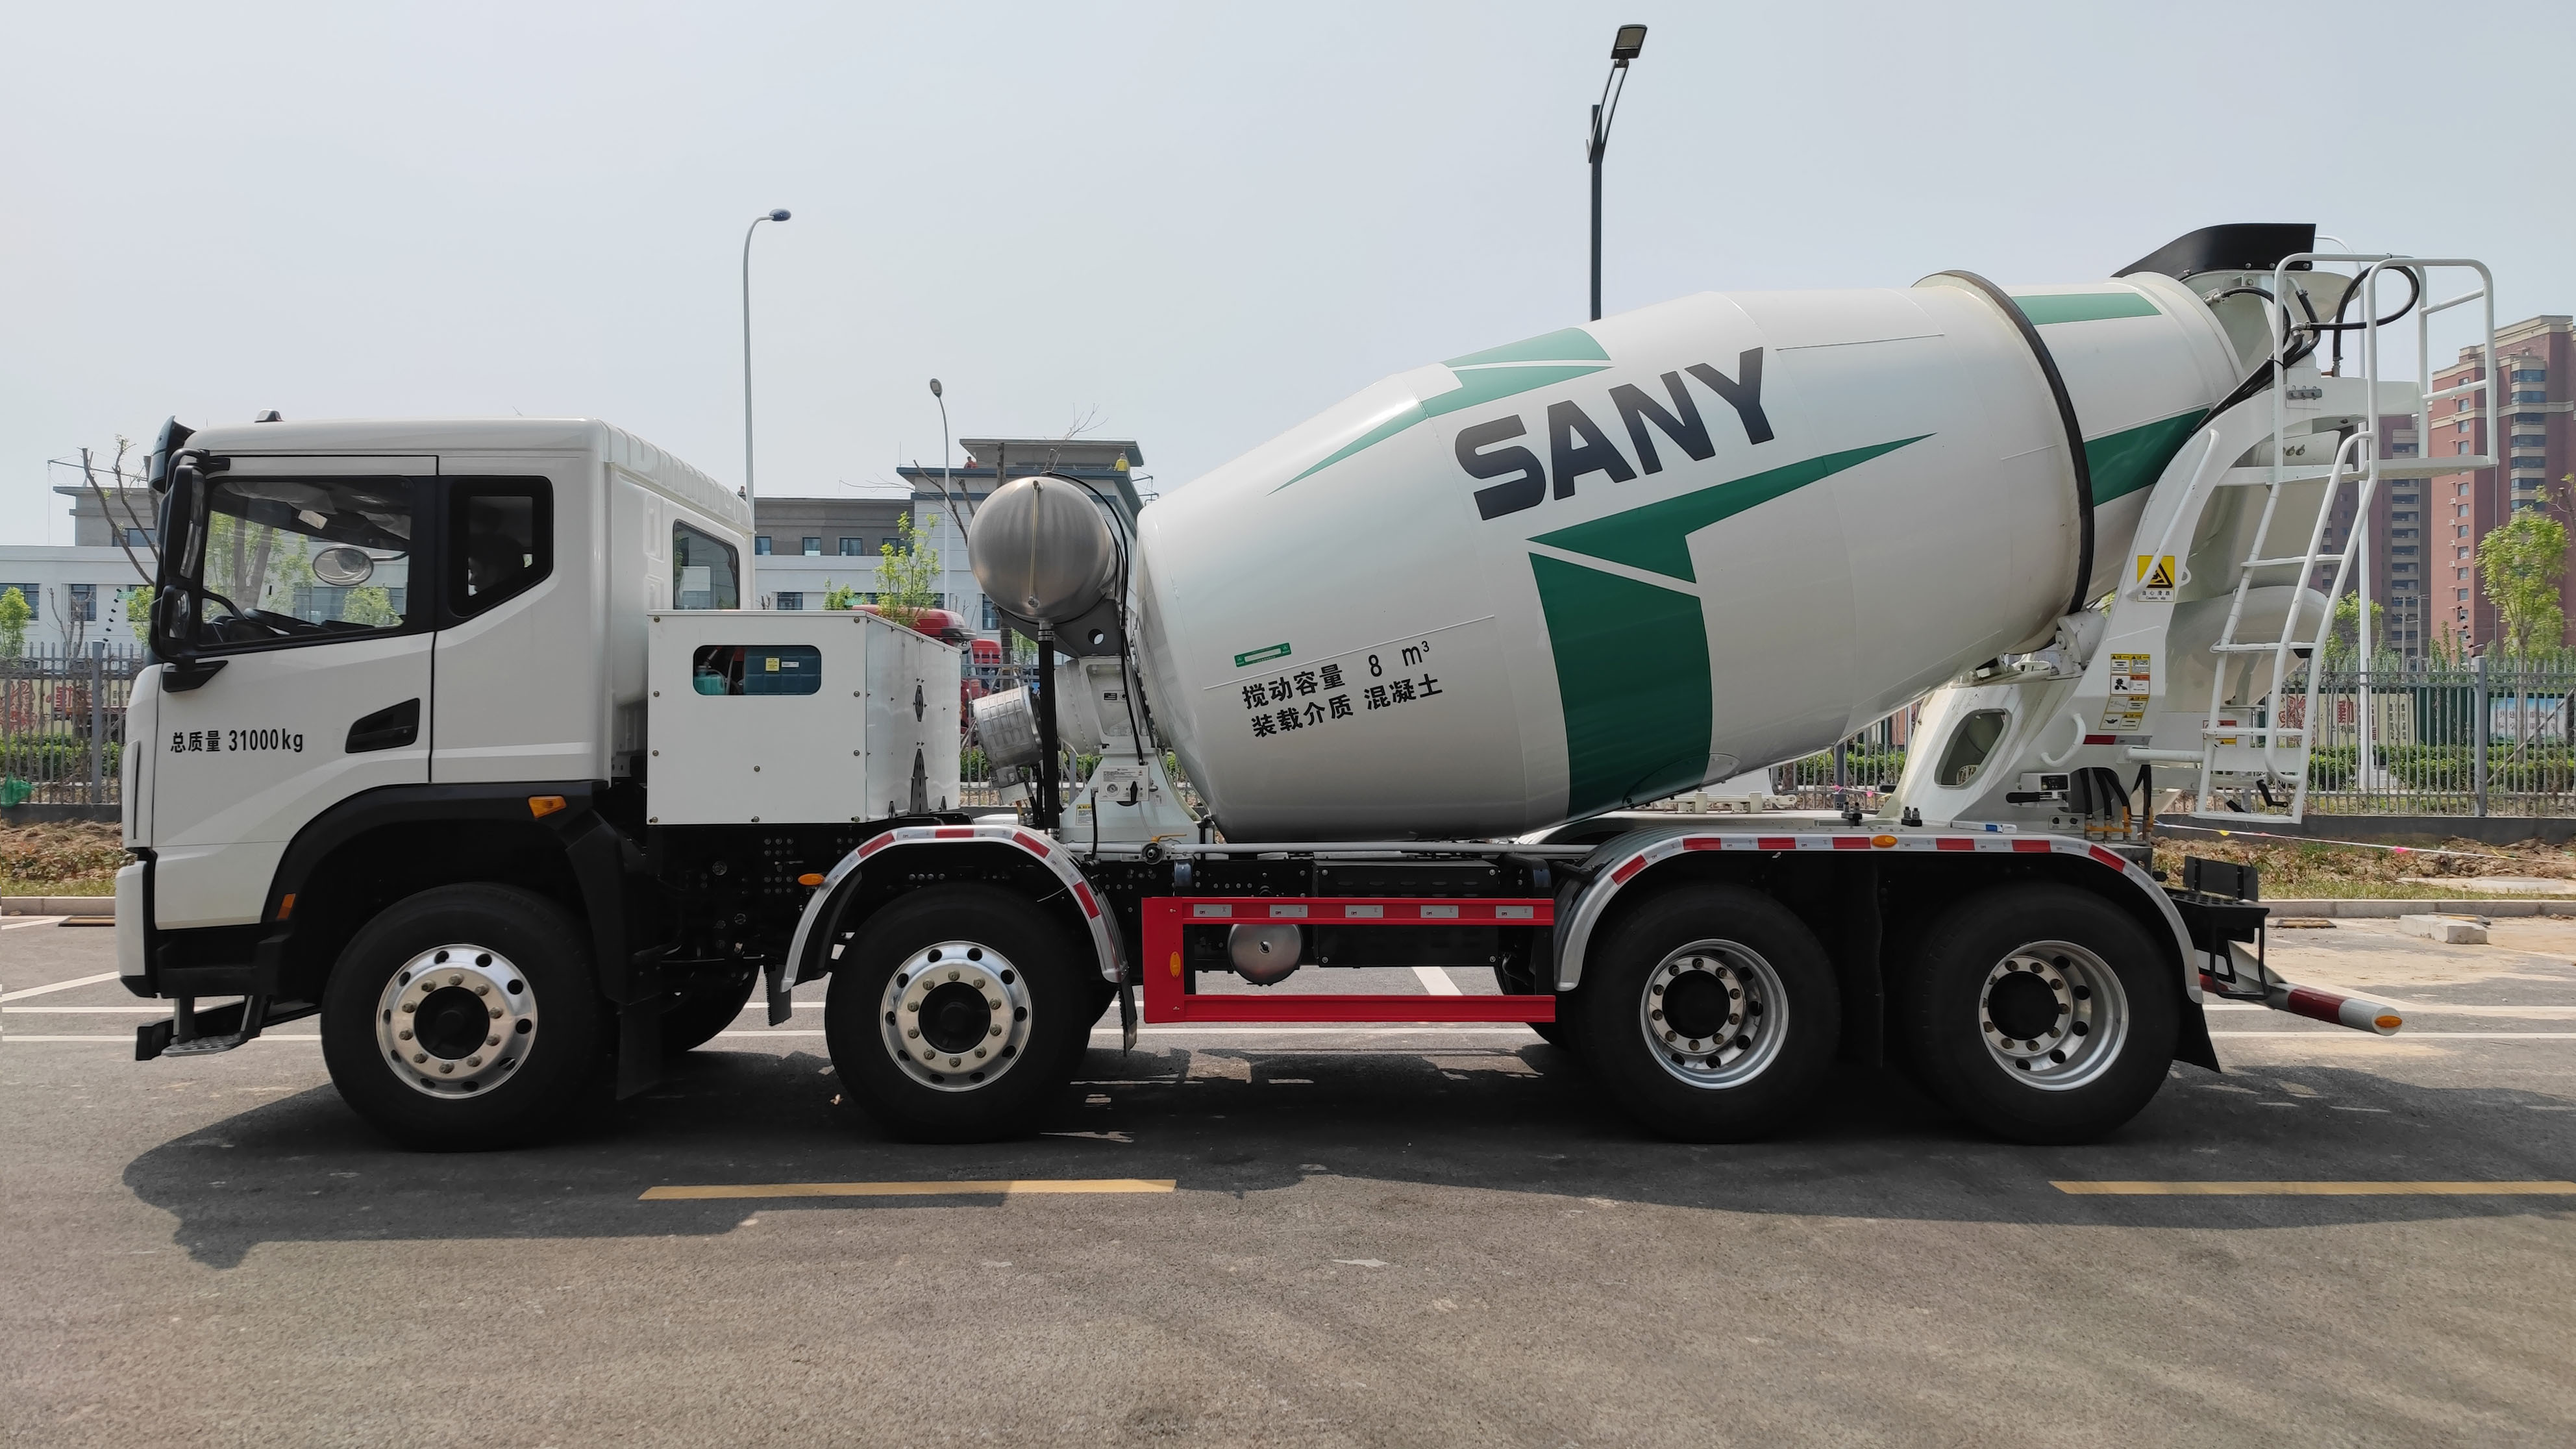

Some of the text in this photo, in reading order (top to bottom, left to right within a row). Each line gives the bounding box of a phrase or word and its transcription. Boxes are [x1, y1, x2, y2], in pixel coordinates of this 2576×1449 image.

[1454, 346, 1774, 521] SANY
[1241, 663, 1346, 710] 搅动容量
[1368, 654, 1383, 677] 8
[1250, 673, 1443, 738] 装载介质 混凝土
[170, 728, 303, 753] 总质量 31000kg
